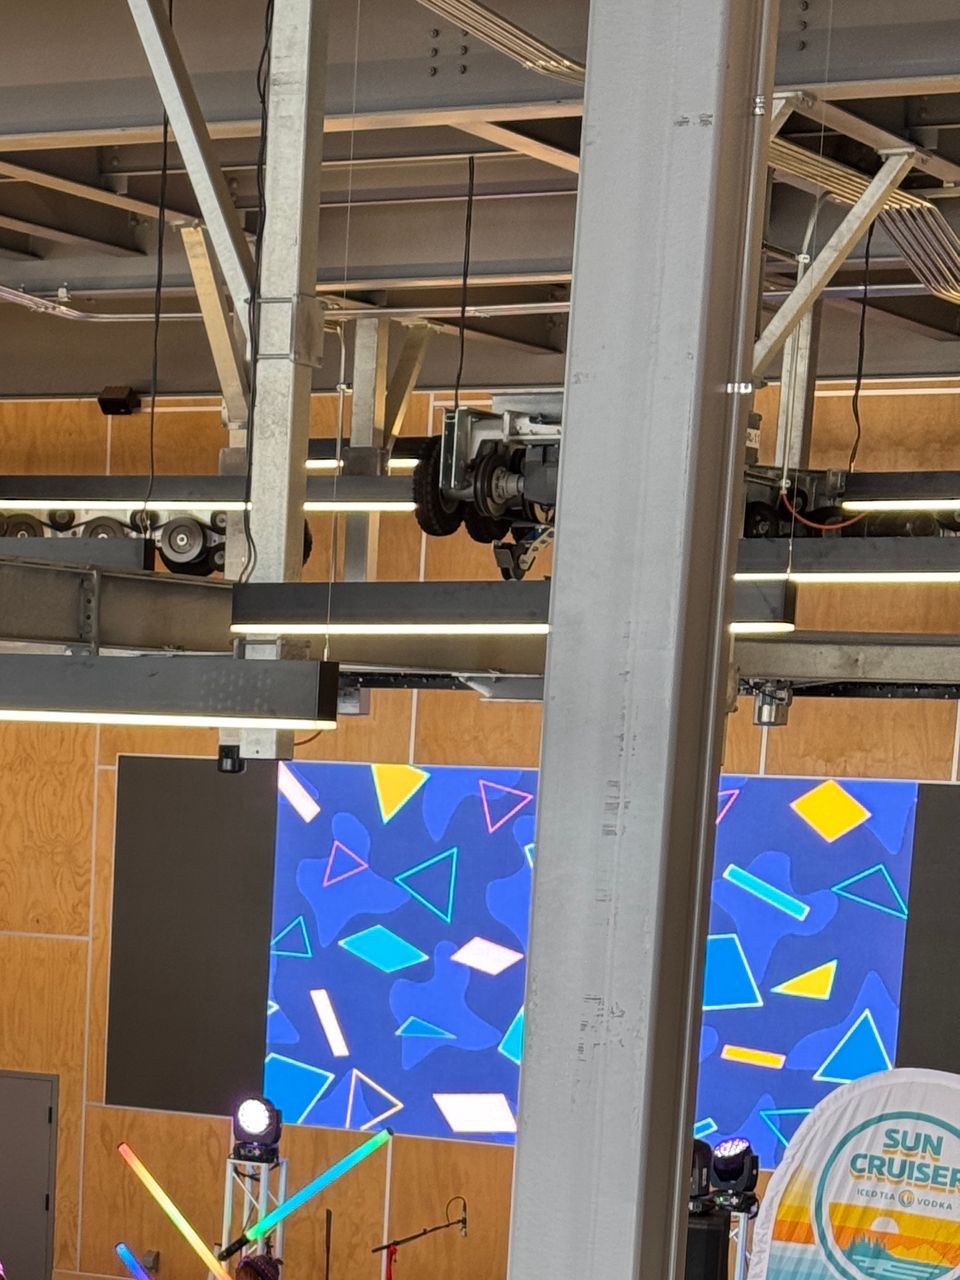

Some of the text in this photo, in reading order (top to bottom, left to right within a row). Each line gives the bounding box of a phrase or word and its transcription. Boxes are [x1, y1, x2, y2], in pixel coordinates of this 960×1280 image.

[882, 1128, 944, 1158] SUN
[857, 1188, 953, 1211] ICED TEA VODKA
